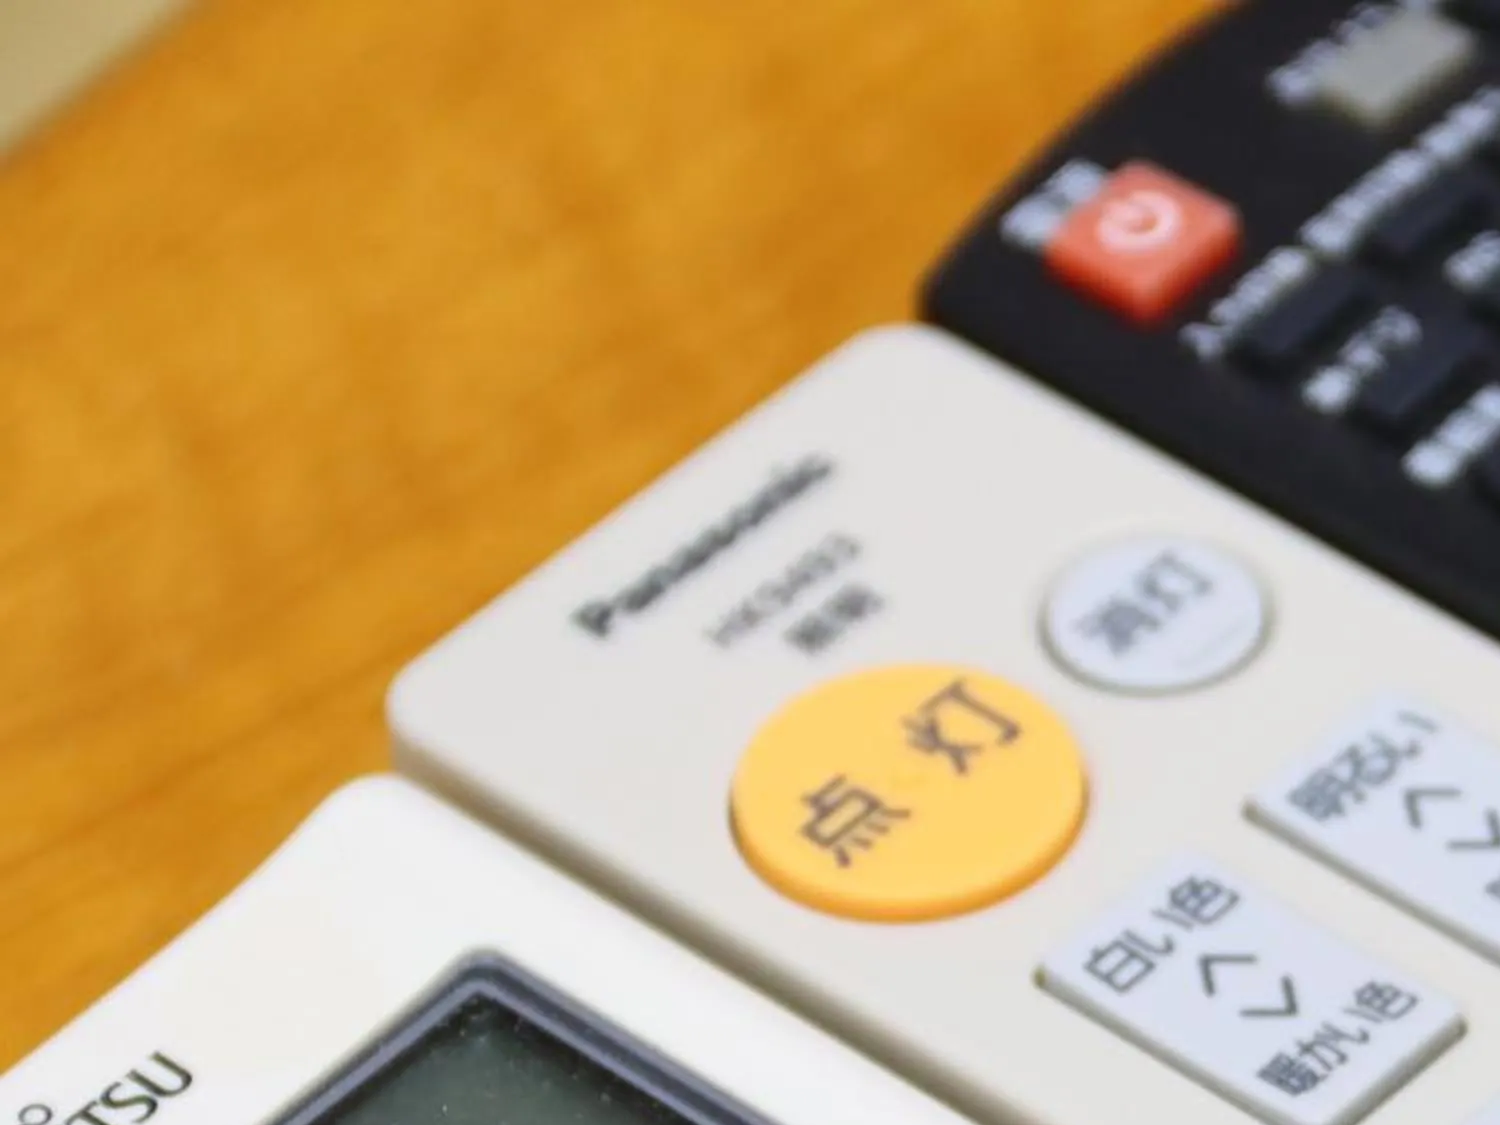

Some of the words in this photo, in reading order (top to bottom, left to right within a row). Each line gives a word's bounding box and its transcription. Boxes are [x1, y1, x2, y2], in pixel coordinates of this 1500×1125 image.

[1288, 709, 1437, 822] 明るい
[1083, 876, 1241, 994] 白い色
[1257, 981, 1420, 1097] 暖かい色
